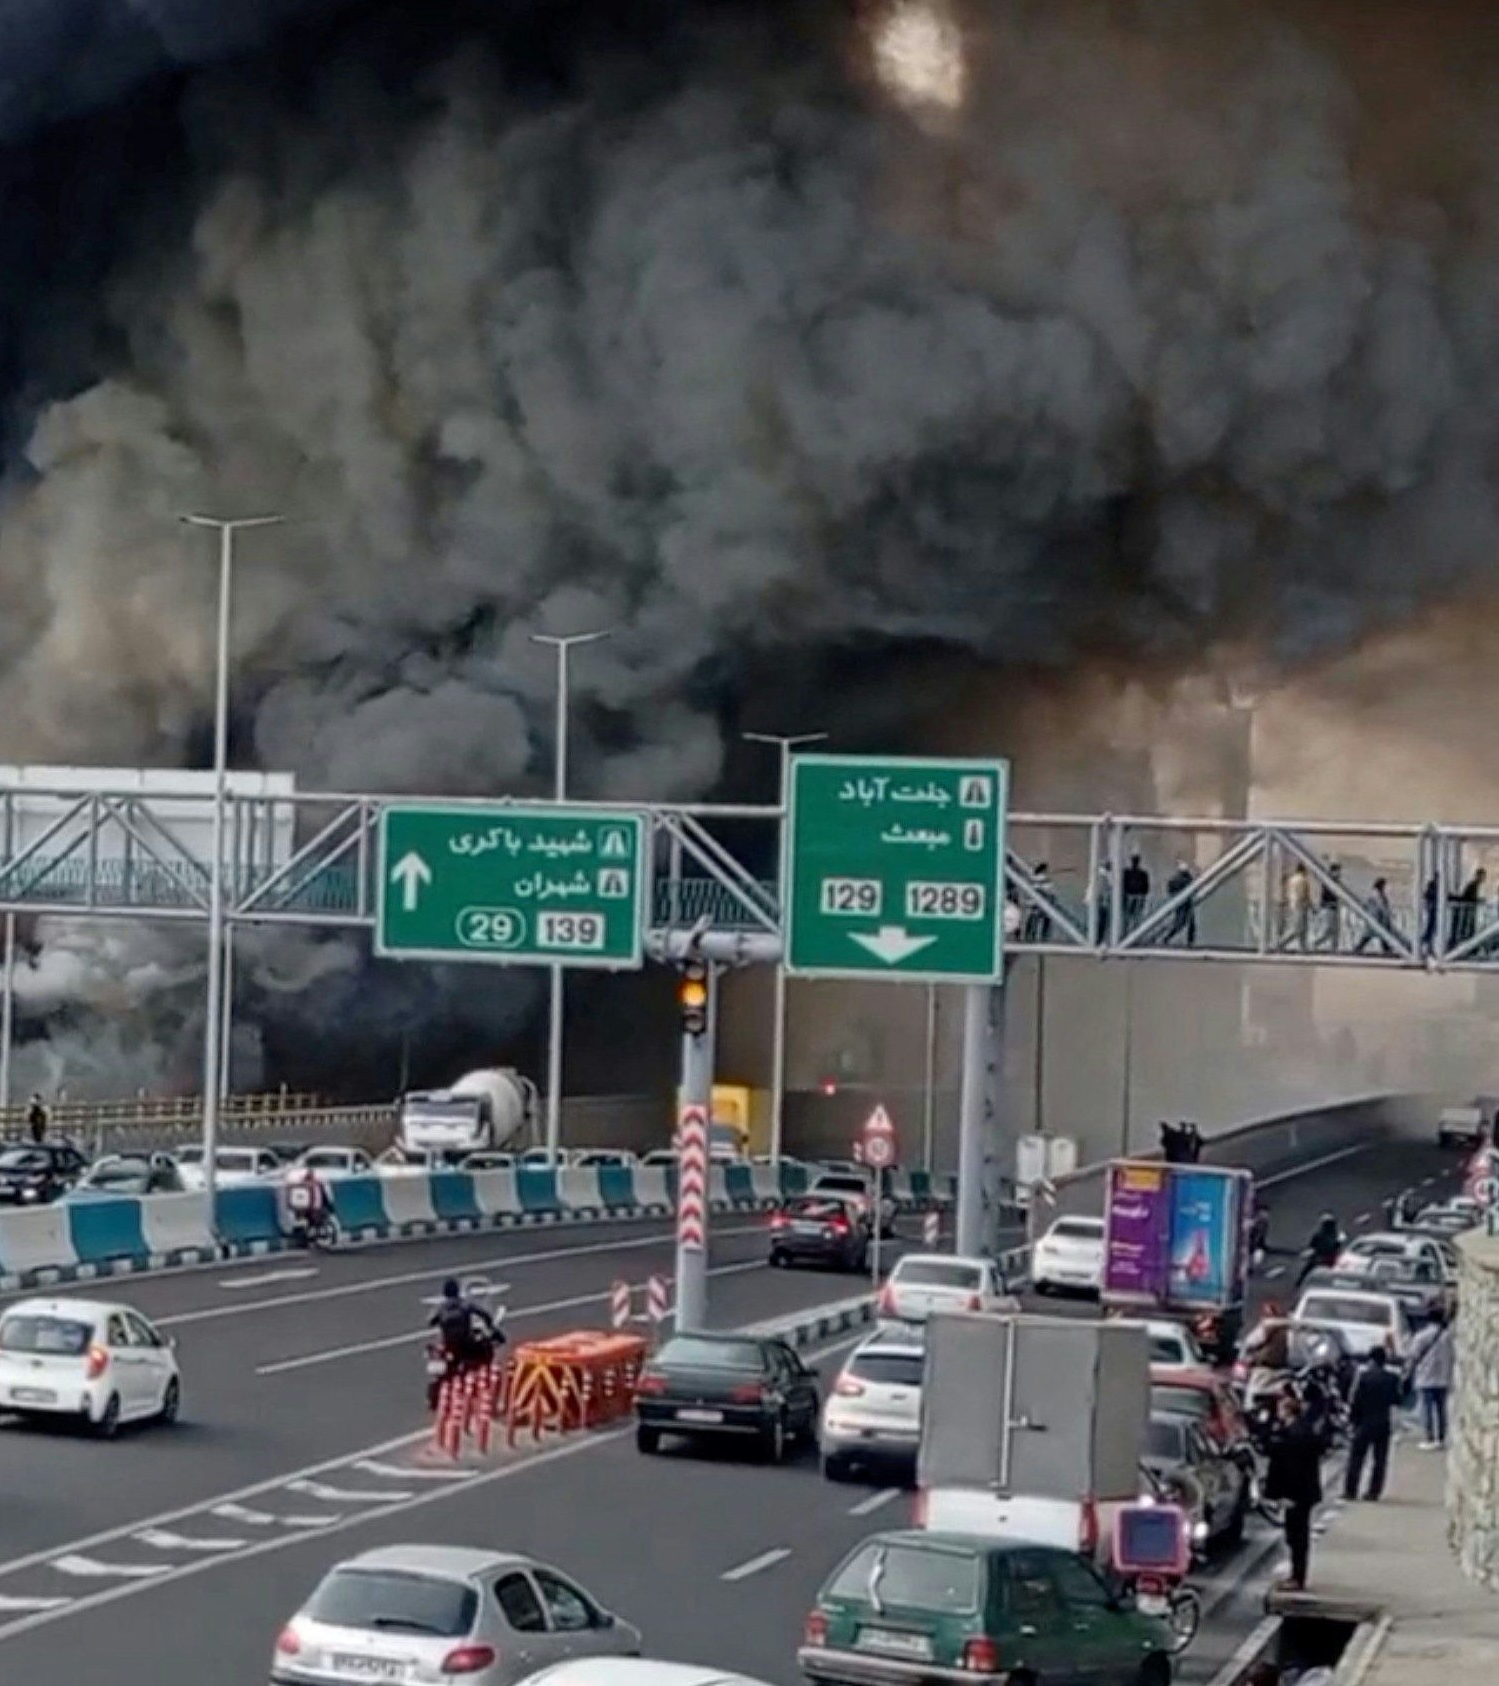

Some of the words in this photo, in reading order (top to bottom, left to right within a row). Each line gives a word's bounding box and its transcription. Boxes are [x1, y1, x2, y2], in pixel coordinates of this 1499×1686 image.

[838, 777, 890, 808] آباد
[449, 827, 521, 857] باکری
[527, 829, 593, 858] شهید
[881, 822, 951, 851] مبعث
[514, 870, 591, 900] شهران
[827, 883, 878, 912] 129
[911, 886, 980, 915] 1289
[468, 912, 513, 942] 29
[545, 917, 597, 944] 139
